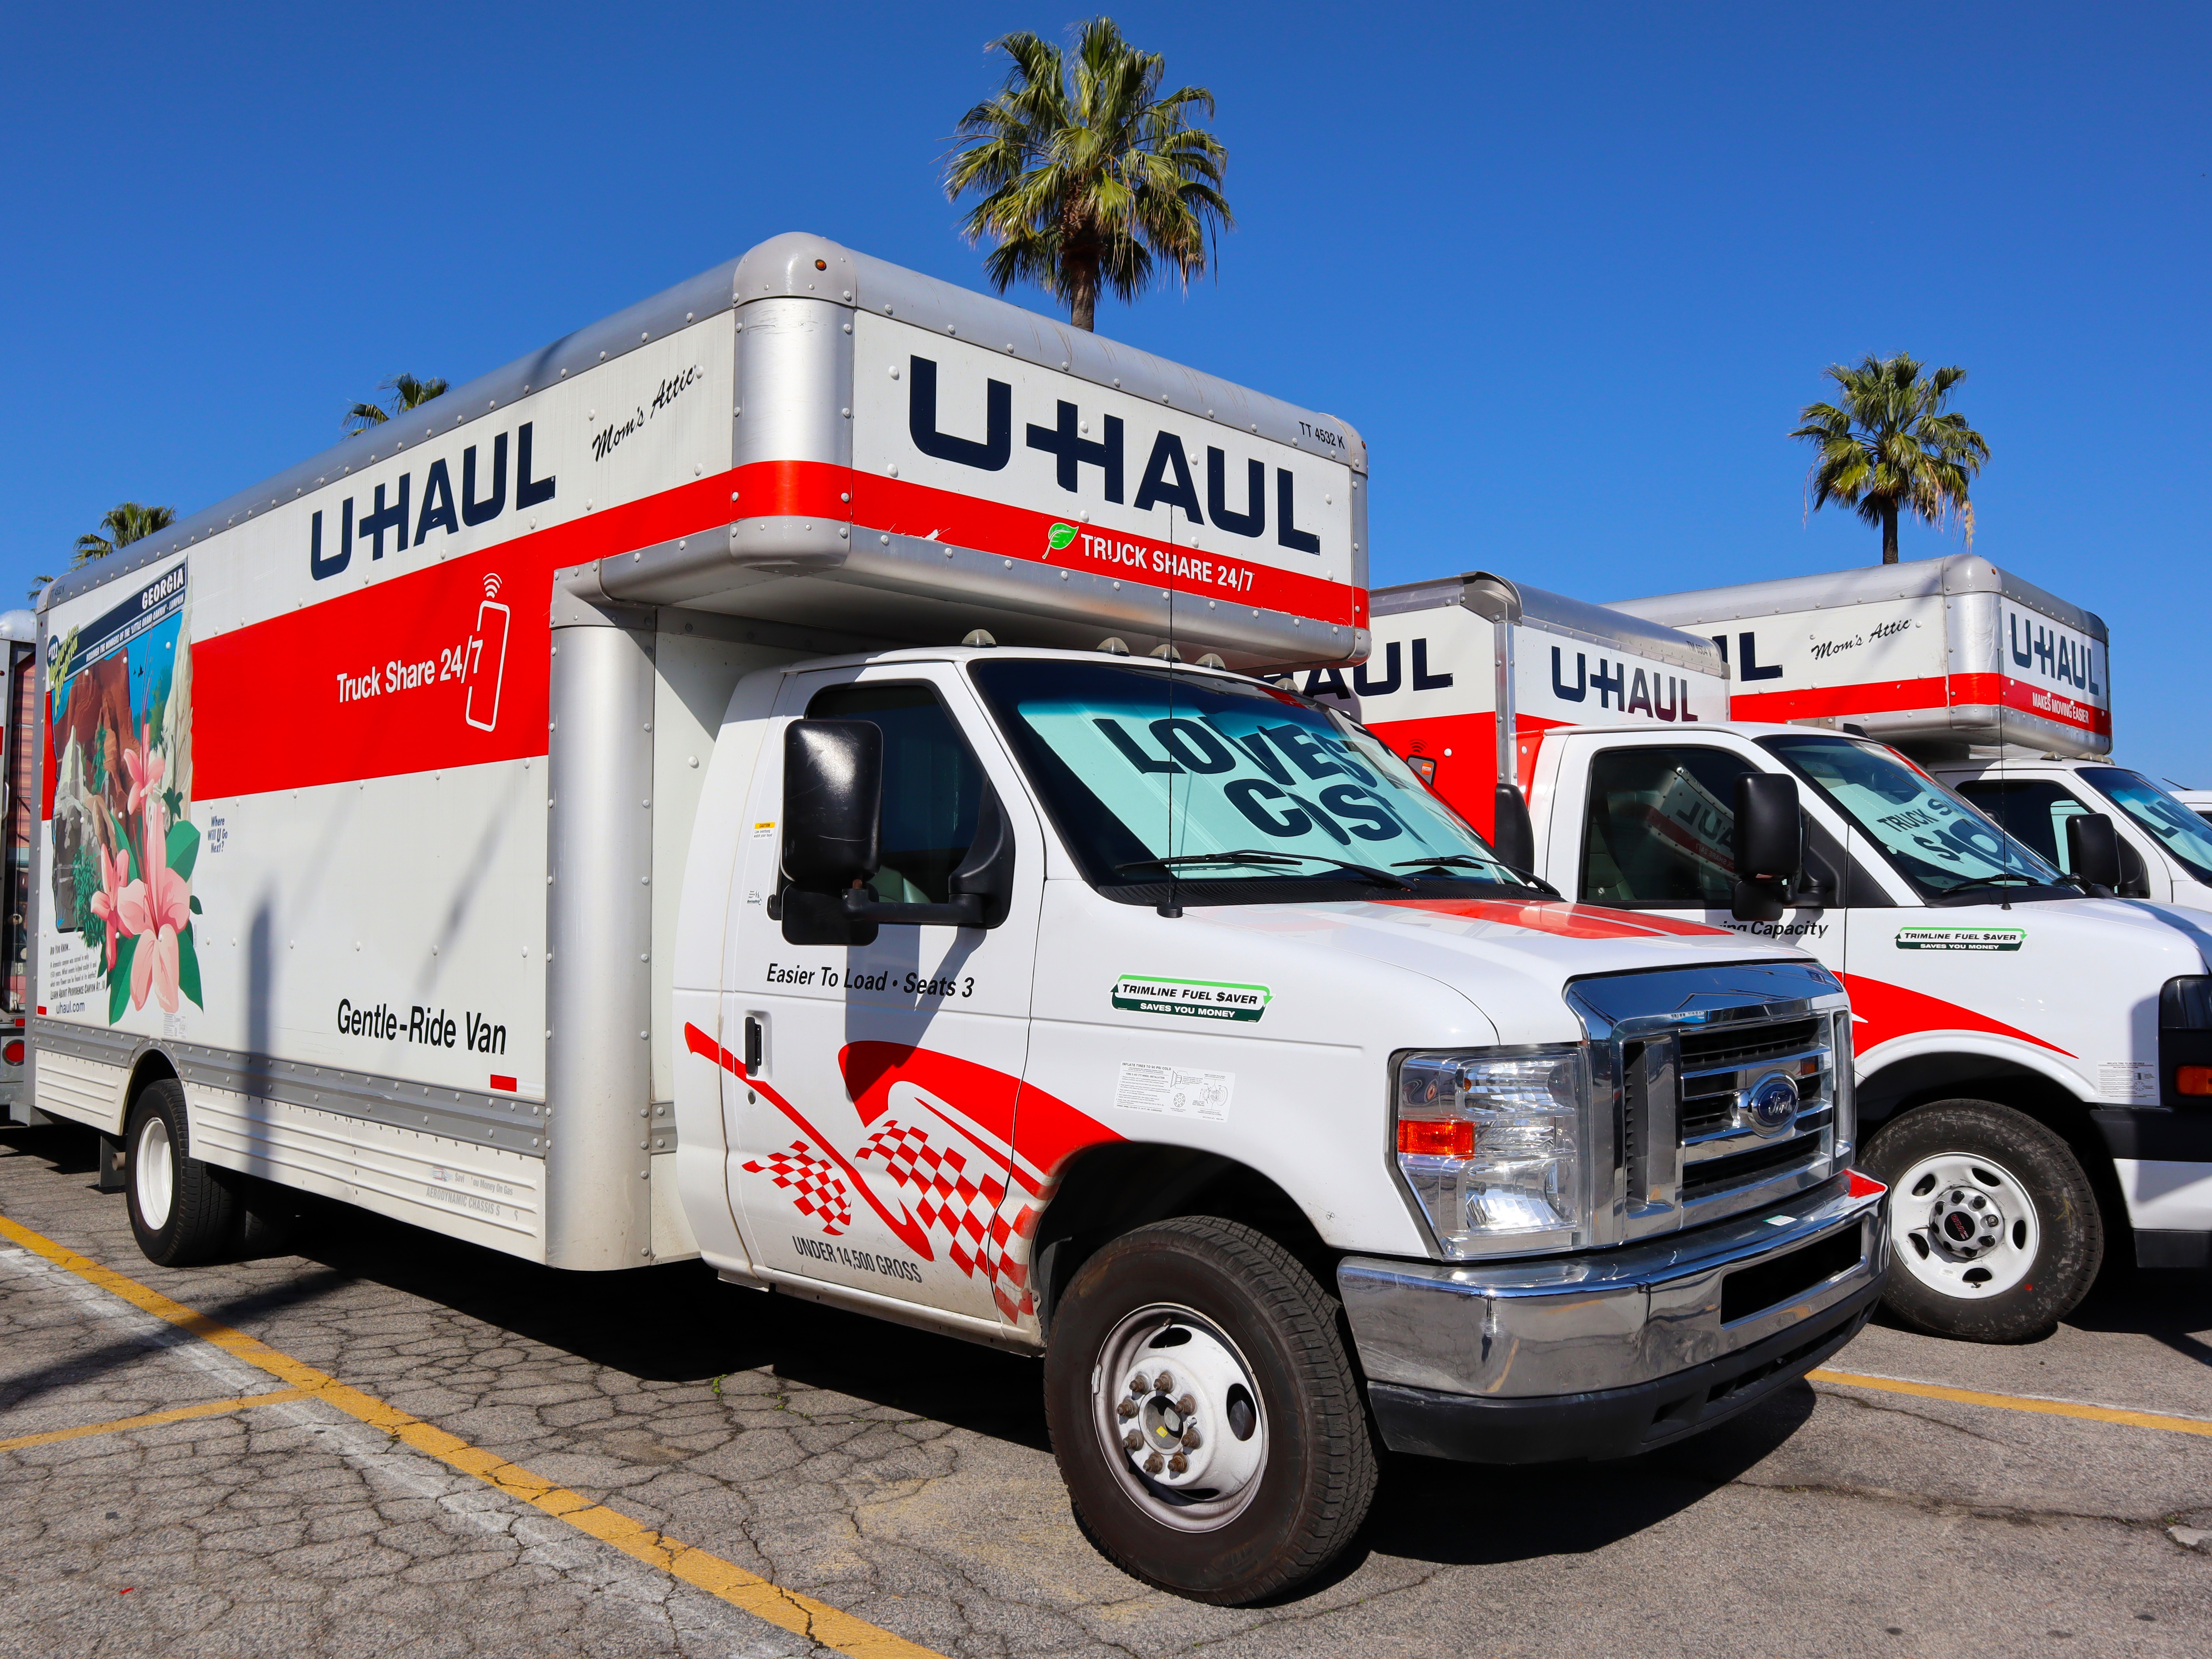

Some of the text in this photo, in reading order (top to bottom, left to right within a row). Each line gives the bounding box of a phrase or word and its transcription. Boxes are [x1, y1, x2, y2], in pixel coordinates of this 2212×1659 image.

[592, 367, 694, 462] Mom's Attic
[1299, 421, 1345, 450] TT 4532 K
[909, 354, 1320, 556] U-HAUL
[311, 421, 556, 580] U-HAUL
[1080, 533, 1253, 591] TRUCK SHARE 24/7
[142, 568, 184, 610] GEORGIA
[48, 641, 58, 661] #122
[1811, 635, 1864, 660] Mom's
[1869, 620, 1910, 643] Attic
[2010, 613, 2099, 696] U-HAUL
[337, 635, 483, 703] Truck Share 24/7
[1551, 646, 1698, 722] U-HAUL
[2032, 692, 2089, 724] MAKES MOVING EASIER
[211, 815, 224, 827] Where
[1876, 808, 1939, 832] TRUCK
[208, 828, 228, 843] Will U Go
[1751, 920, 1829, 939] Capacity
[767, 963, 975, 997] Easier To Load Seats 3
[1122, 984, 1258, 1005] TRIMLINE FUEL $AVER
[56, 1000, 85, 1014] uhaul.com
[1140, 1002, 1236, 1018] SAVES YOU MONEY
[338, 998, 506, 1055] Gentle-Ride Van
[1768, 1090, 1793, 1116] Ford
[426, 1187, 467, 1207] AERODYNAMIC
[469, 1197, 494, 1215] CHASSIS
[480, 1180, 495, 1193] Money
[496, 1183, 503, 1193] On
[504, 1185, 513, 1196] Gas
[1951, 1214, 1969, 1239] GMC
[792, 1235, 922, 1283] UNDER 14,500 GROSS
